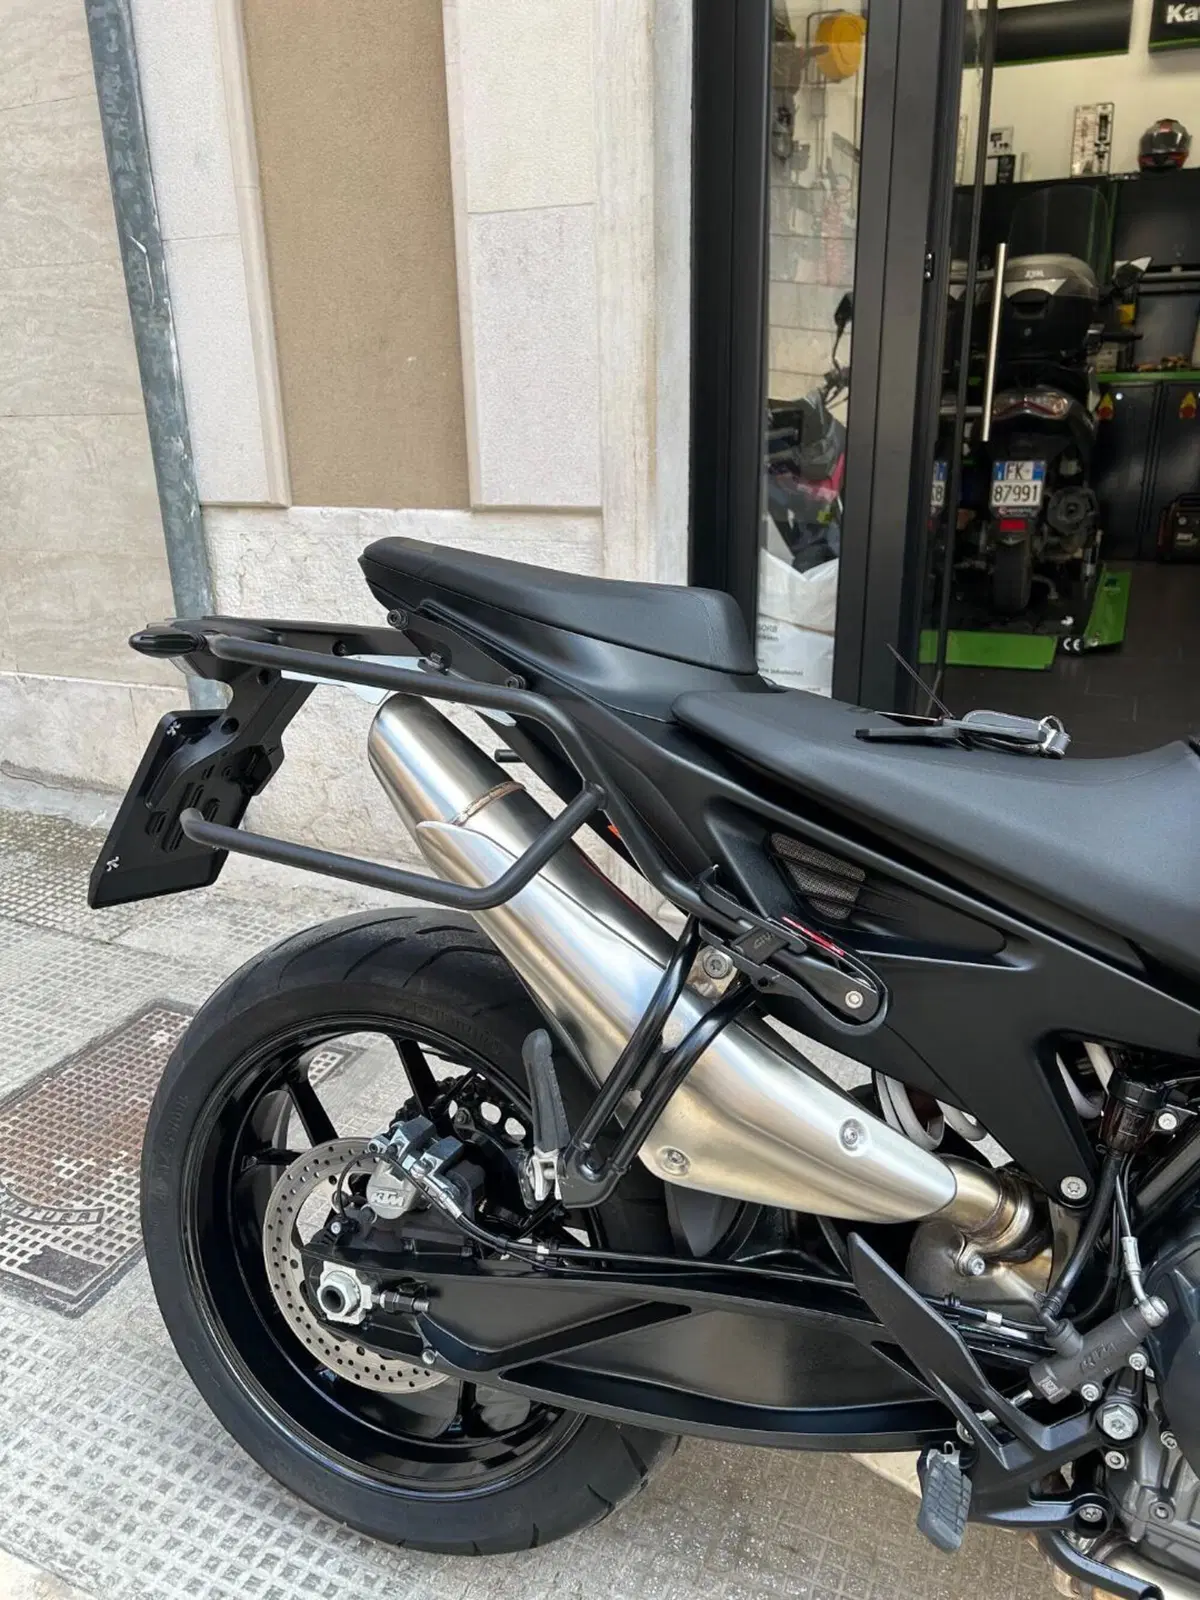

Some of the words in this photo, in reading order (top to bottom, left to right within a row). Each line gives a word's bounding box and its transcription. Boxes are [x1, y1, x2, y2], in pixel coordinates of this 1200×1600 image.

[1166, 3, 1200, 24] Ka
[993, 484, 1037, 503] 87991
[370, 1189, 405, 1206] KTM
